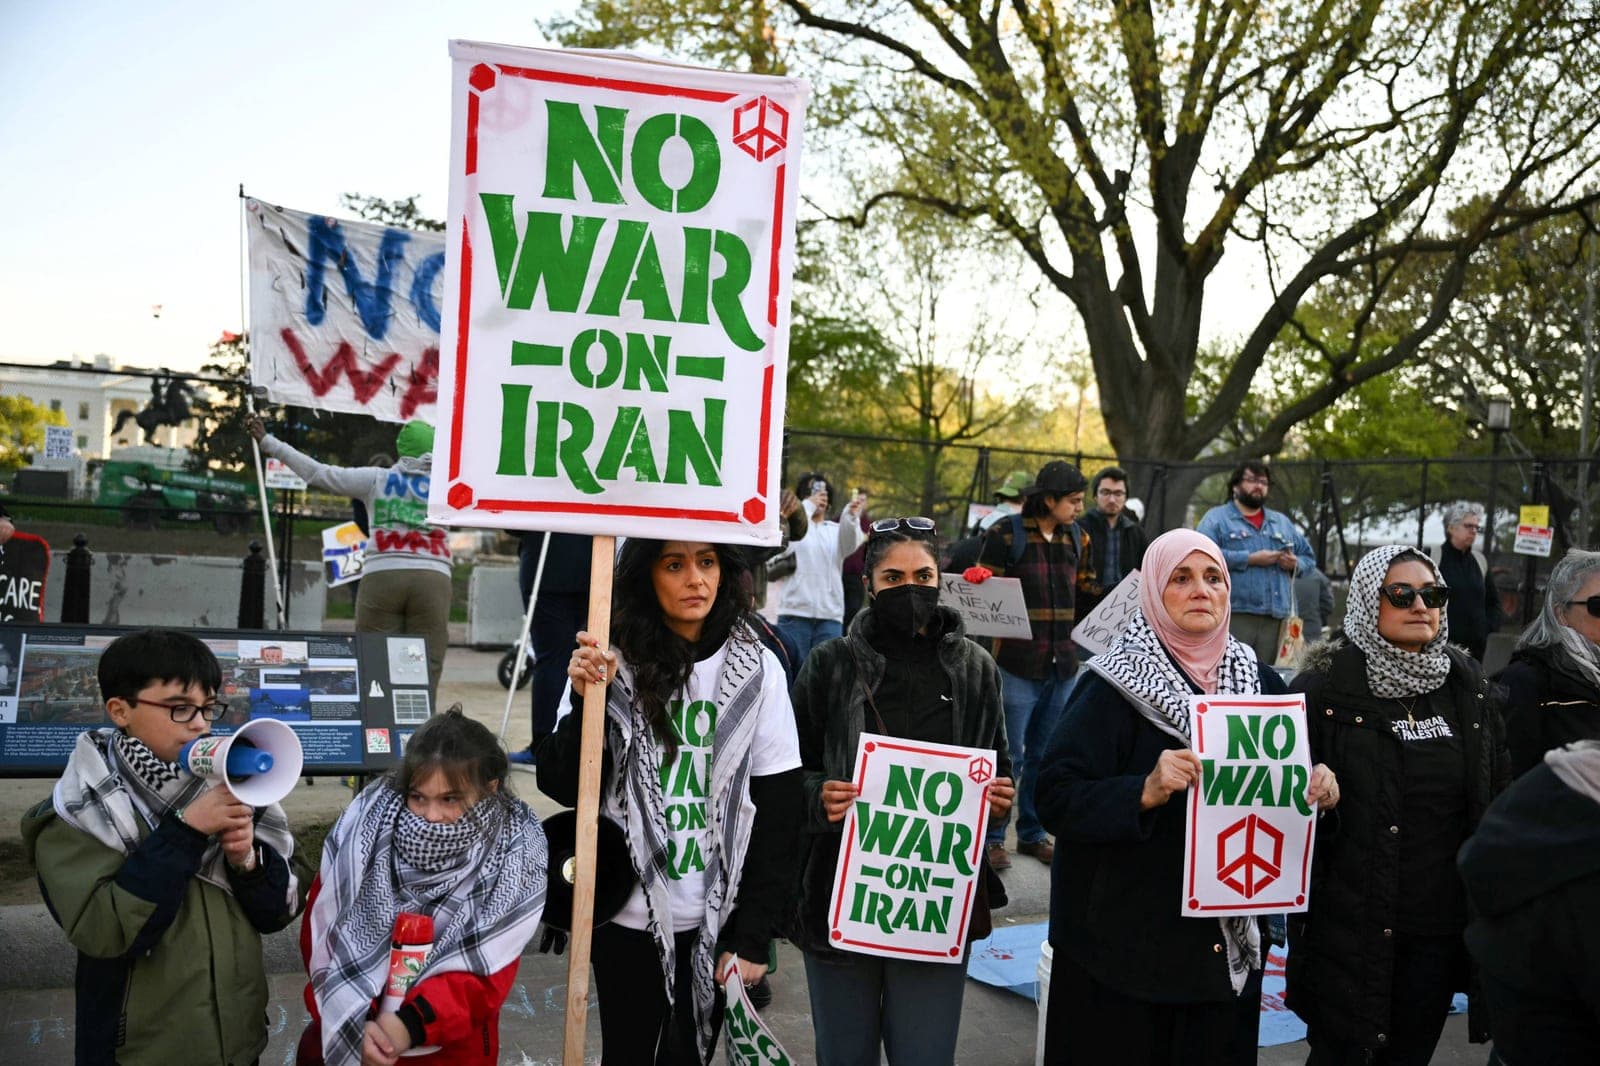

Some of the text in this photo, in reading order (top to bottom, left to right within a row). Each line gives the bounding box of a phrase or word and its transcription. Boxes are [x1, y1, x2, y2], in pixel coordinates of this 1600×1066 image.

[543, 100, 721, 213] NO
[479, 193, 766, 352] WAR
[496, 383, 727, 495] IRAN
[375, 528, 450, 558] WAR
[958, 596, 1003, 612] NEW
[1226, 714, 1296, 760] NO
[883, 764, 963, 817] NO
[1201, 759, 1313, 817] WAR
[665, 802, 706, 832] ON
[856, 801, 974, 876] WAR
[849, 882, 954, 934] IRAN
